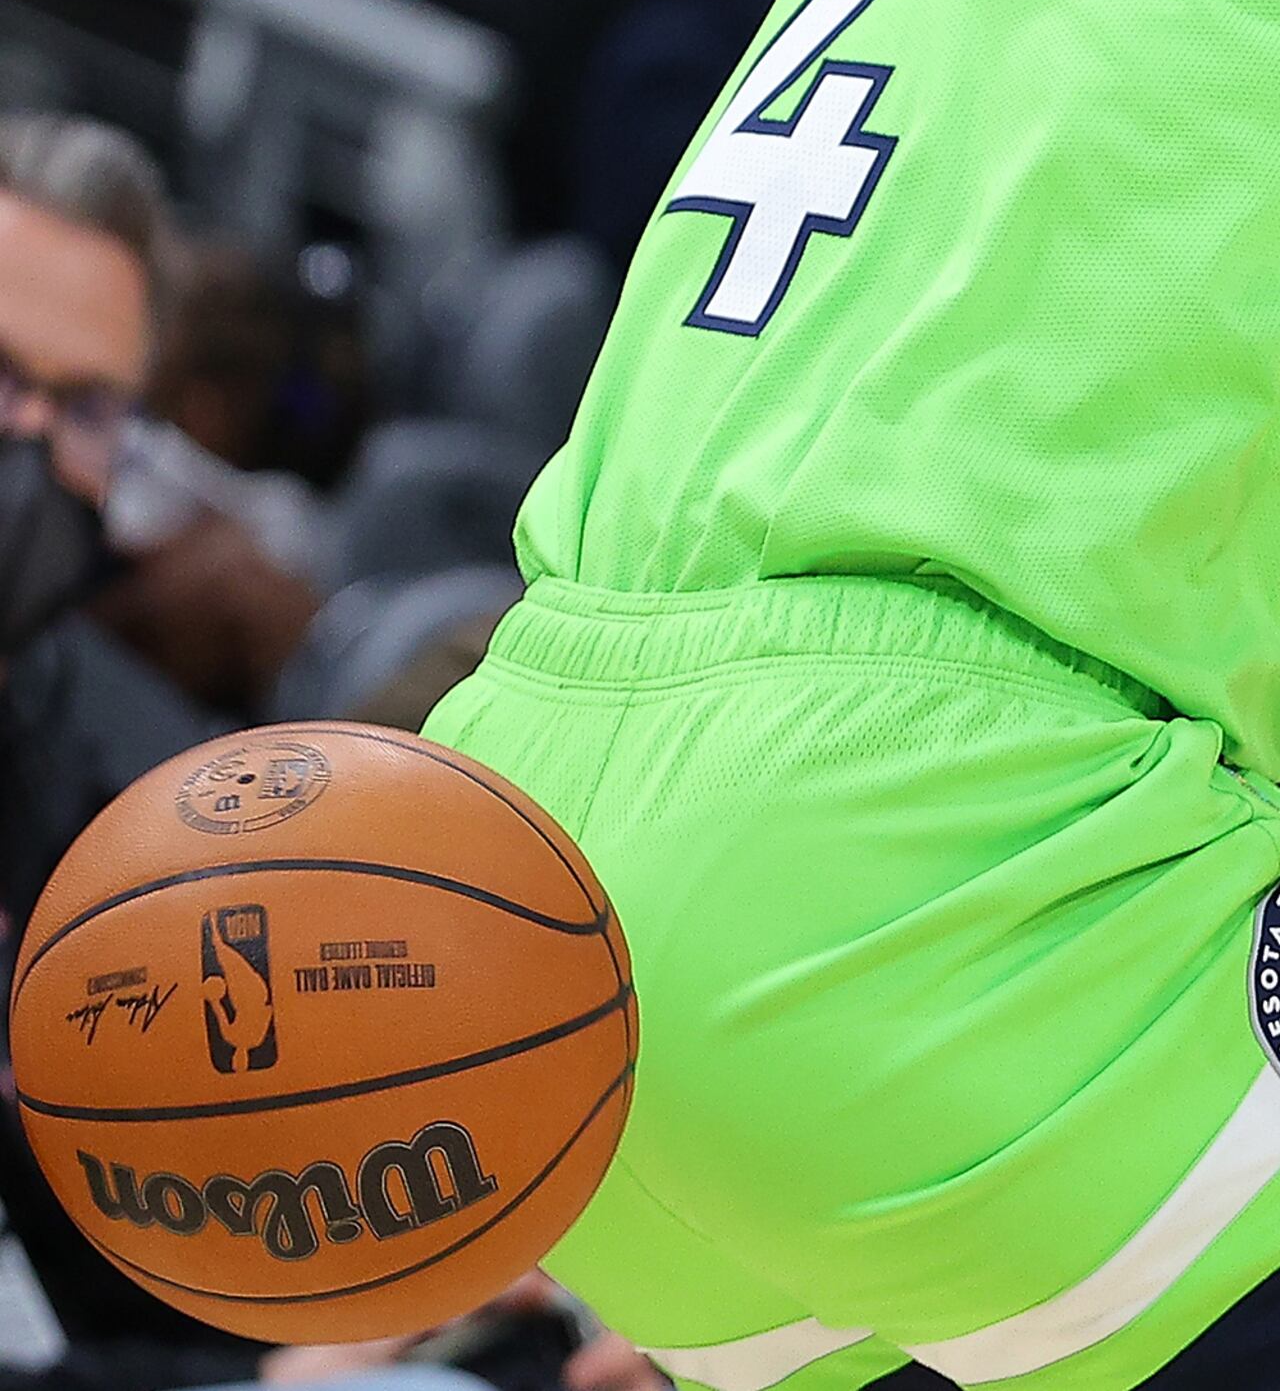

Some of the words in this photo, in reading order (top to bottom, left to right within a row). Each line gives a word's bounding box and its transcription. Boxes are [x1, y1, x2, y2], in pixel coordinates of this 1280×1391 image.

[294, 966, 329, 993] BALL
[331, 964, 371, 991] GAME
[374, 963, 435, 989] OFFICIAL
[77, 1120, 499, 1262] Wilson
